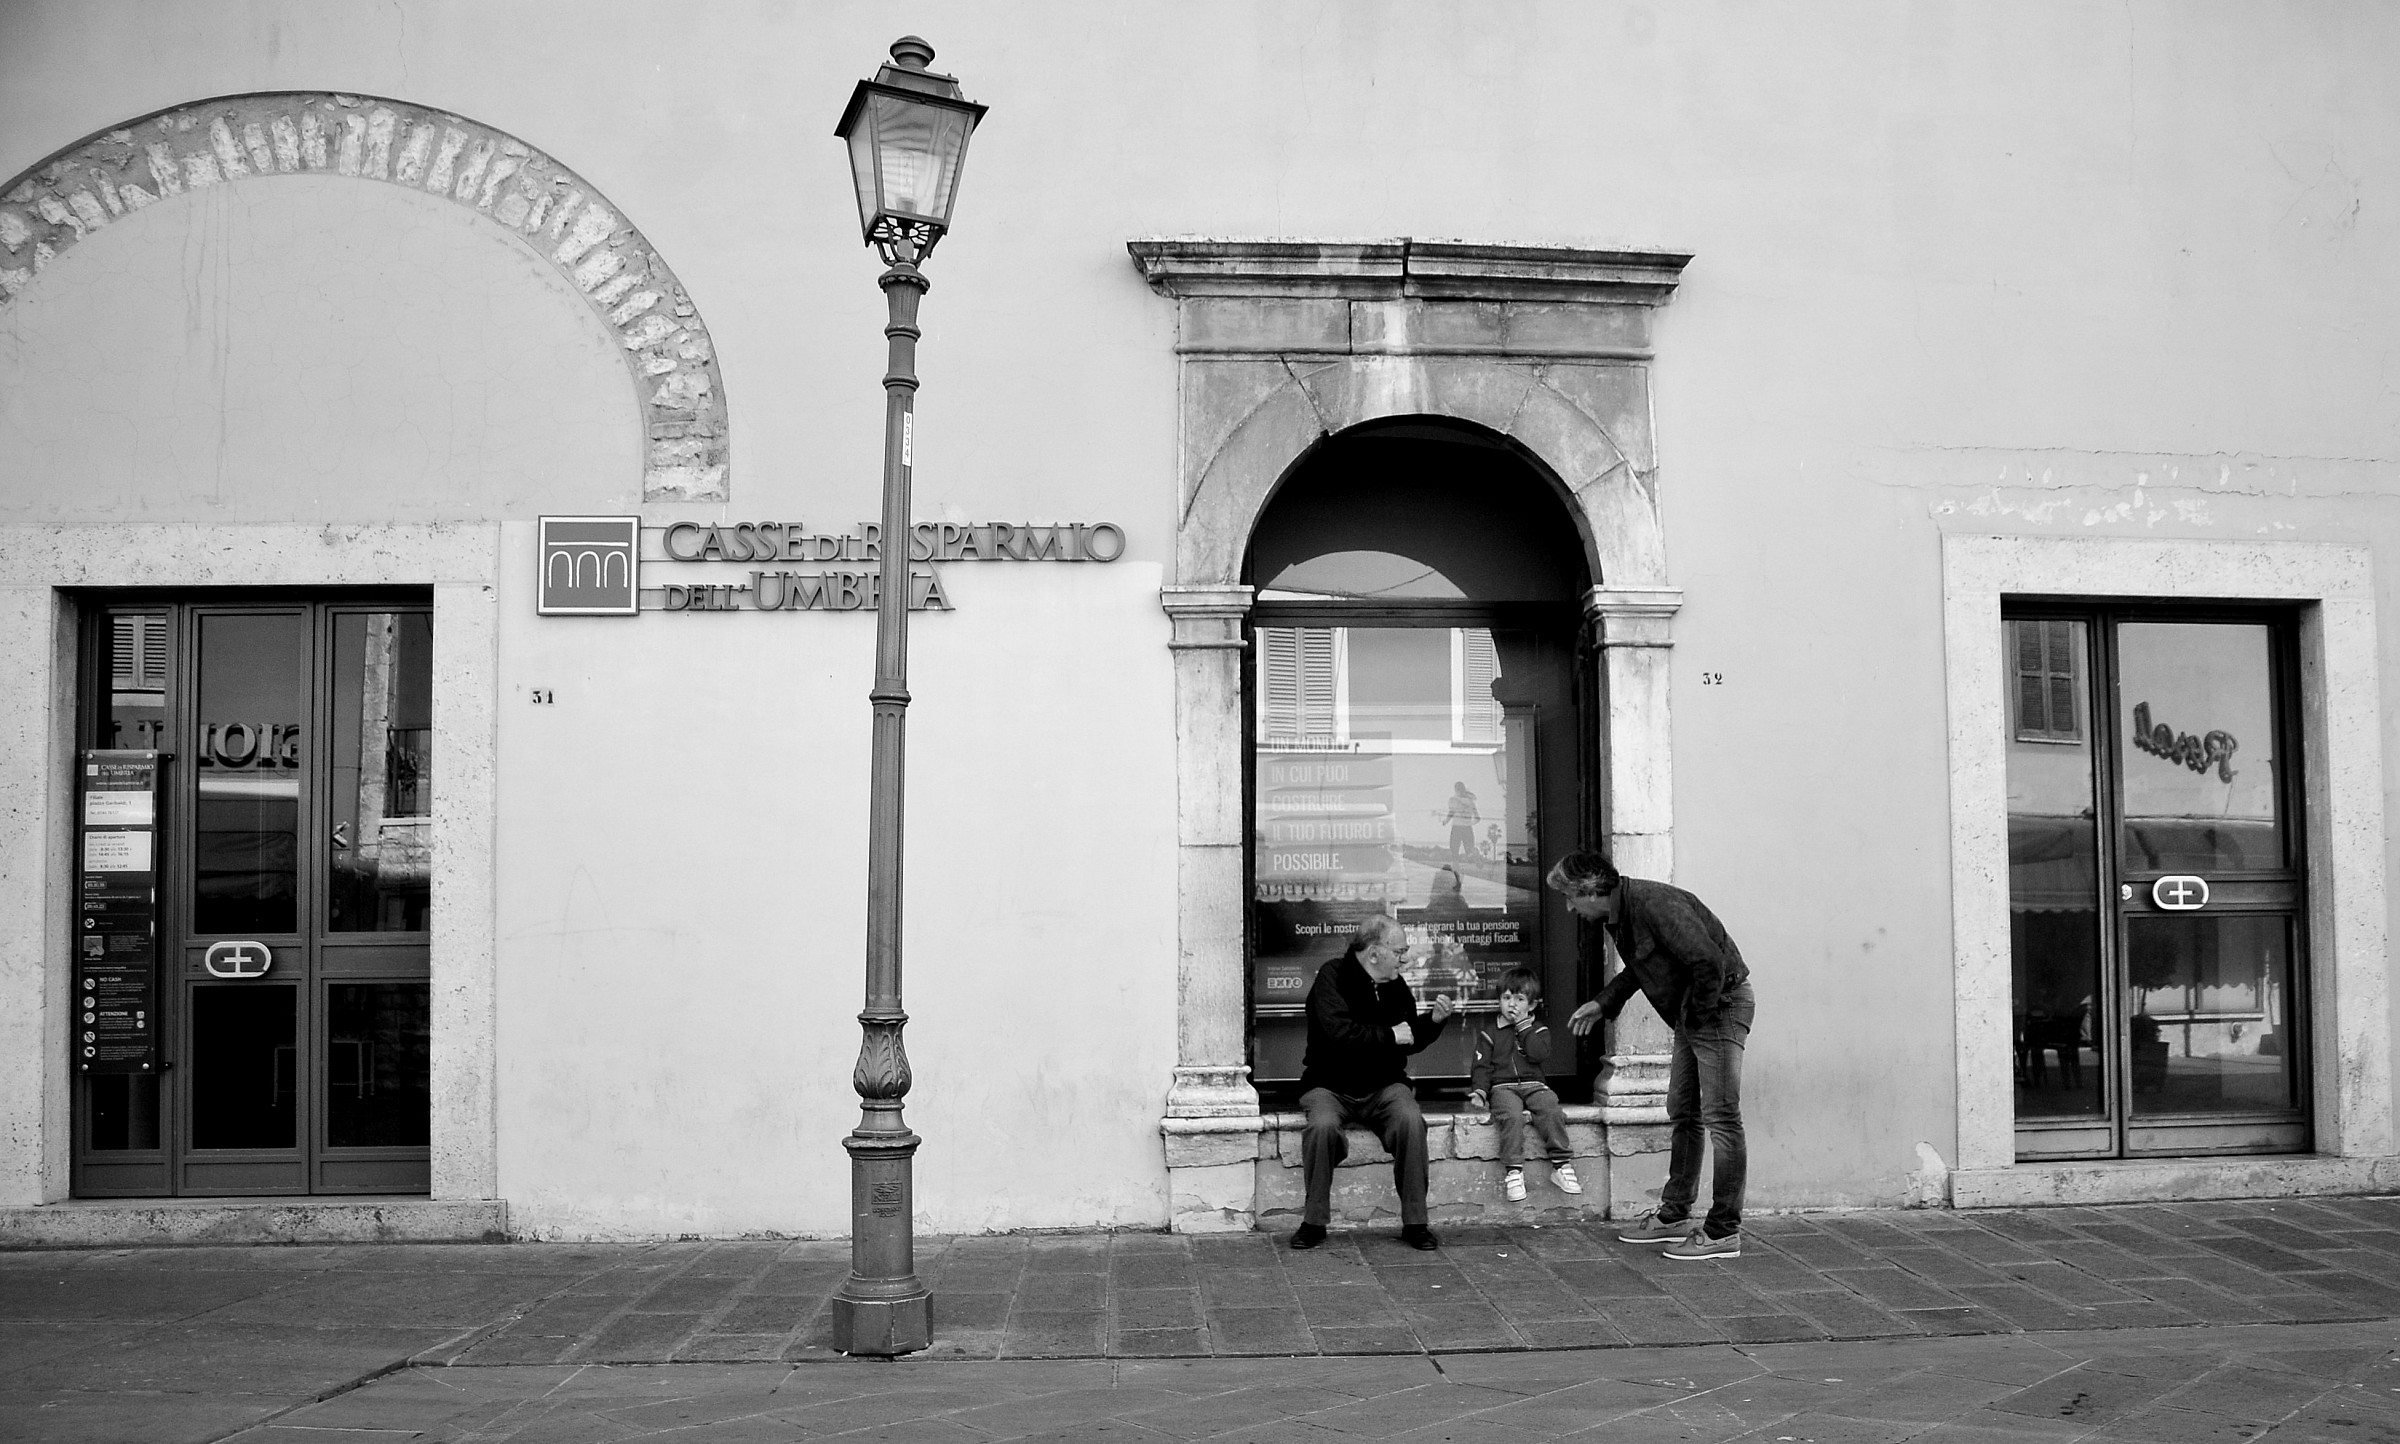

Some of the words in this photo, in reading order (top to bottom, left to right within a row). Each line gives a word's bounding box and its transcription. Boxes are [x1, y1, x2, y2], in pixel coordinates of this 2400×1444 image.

[663, 521, 804, 561] CASSE
[813, 534, 853, 561] DI
[858, 520, 1127, 562] RSPARMIO
[1702, 672, 1723, 685] 32
[532, 689, 554, 704] 31
[1272, 766, 1284, 782] IN
[1290, 765, 1312, 782] CUI
[1317, 765, 1348, 782] PUOI
[1272, 794, 1345, 812] COSTRUIRE
[1273, 824, 1283, 841] IL
[1289, 824, 1315, 841] TUO
[1320, 823, 1372, 840] FUTURO
[1273, 853, 1344, 871] POSSIBILE.
[1295, 923, 1322, 936] Scopri
[1323, 922, 1332, 934] le
[1334, 924, 1360, 934] nostr
[1418, 921, 1455, 933] integrare
[1457, 920, 1465, 930] la
[1466, 921, 1481, 930] tua
[1482, 919, 1520, 932] pensione
[1457, 933, 1492, 946] vantaggi
[1494, 931, 1520, 943] fiscali.
[1267, 977, 1303, 989] EXPO
